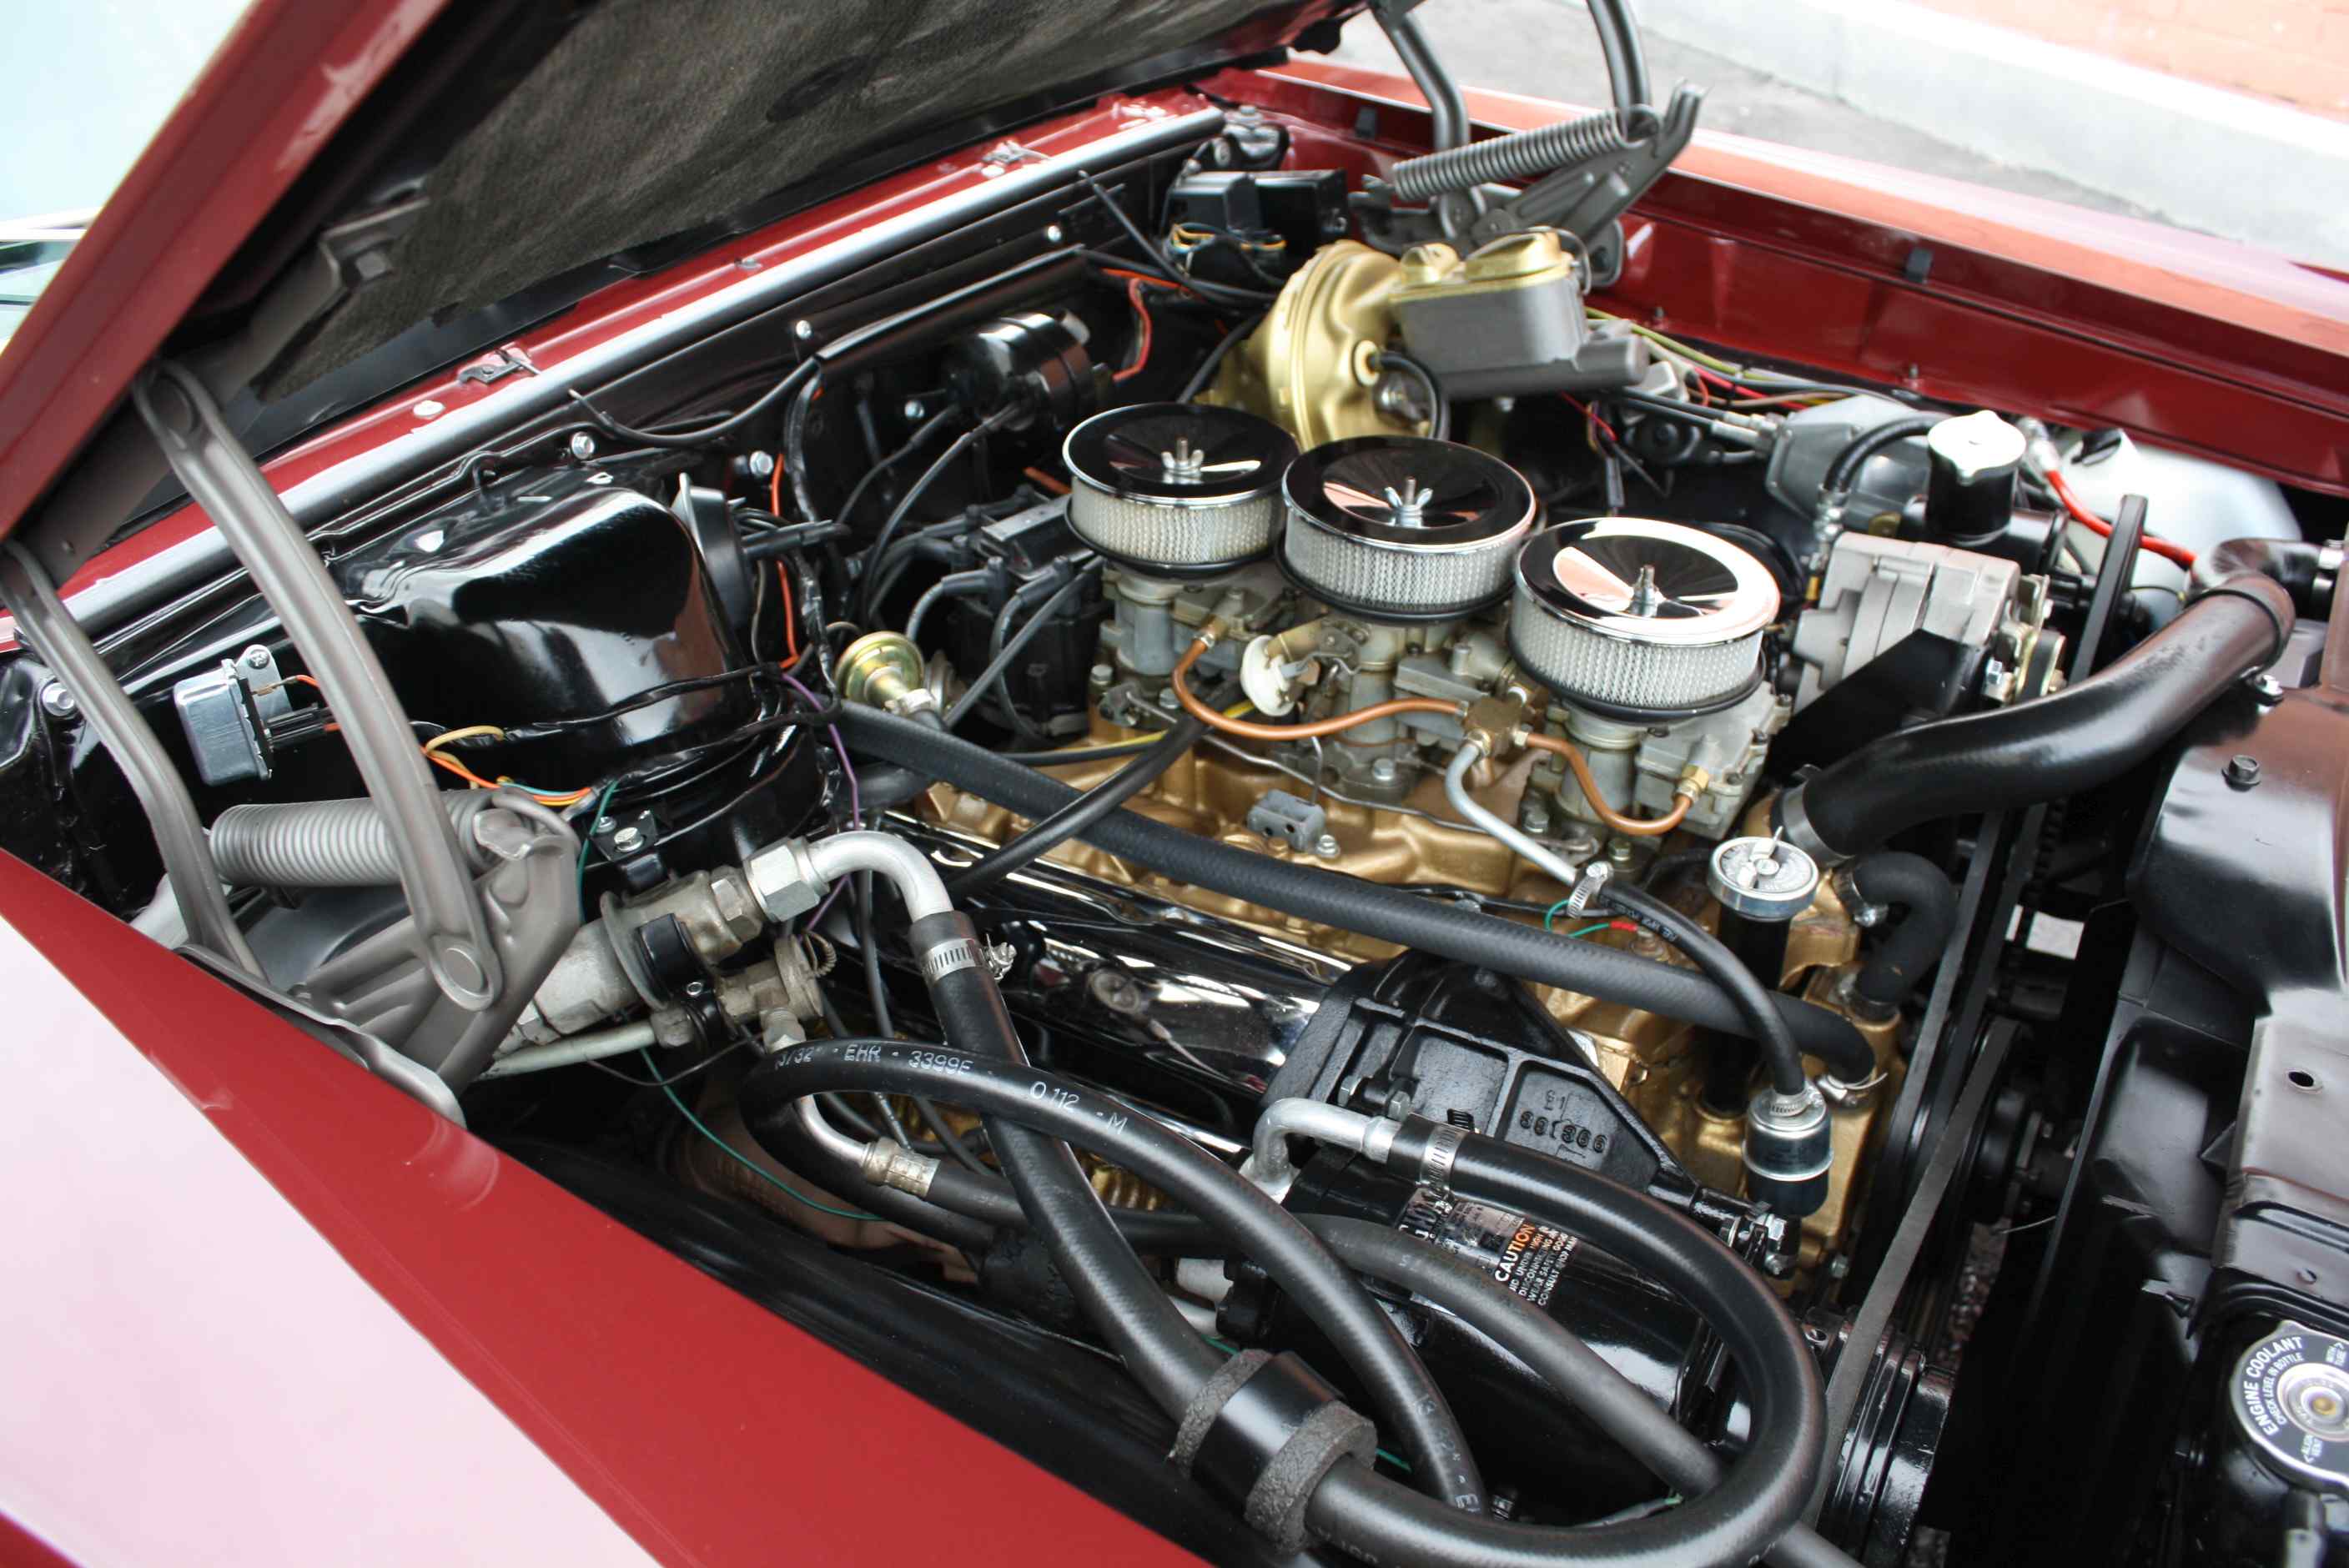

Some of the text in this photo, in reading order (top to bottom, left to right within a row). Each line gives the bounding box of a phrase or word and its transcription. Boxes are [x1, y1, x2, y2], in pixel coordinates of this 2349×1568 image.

[843, 1044, 882, 1063] EHR
[1495, 1224, 1535, 1282] CAUTION
[1537, 1269, 1560, 1306] CONSULT
[2243, 1336, 2304, 1436] ENGINE COOLANT
[2262, 1352, 2305, 1425] CHECK LEVEL IN BOTTLE
